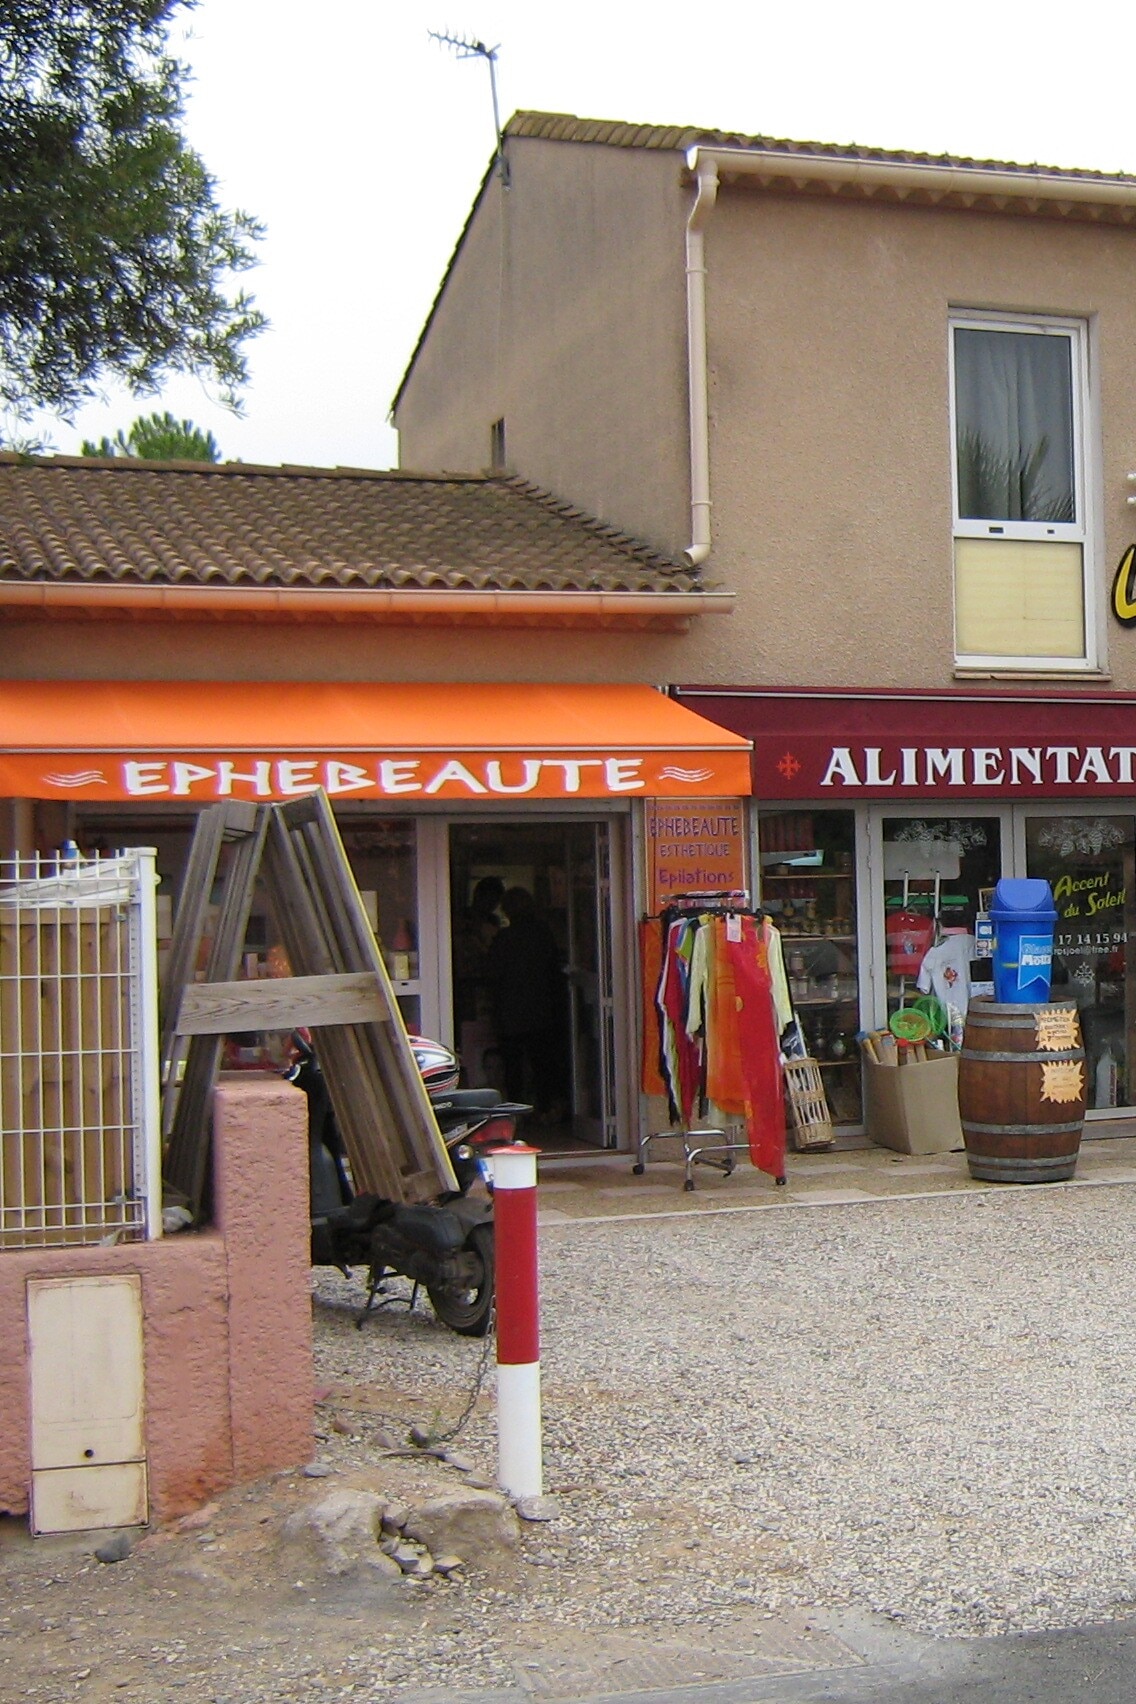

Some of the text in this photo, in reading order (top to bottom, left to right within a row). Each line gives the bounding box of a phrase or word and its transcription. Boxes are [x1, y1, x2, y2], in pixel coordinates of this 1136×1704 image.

[123, 758, 647, 796] EPHEBEAUTE
[650, 816, 739, 837] EPHEBEAUTE
[660, 843, 730, 857] ESTHETIQUE
[658, 868, 735, 889] Epilations
[1053, 871, 1109, 900] Accent
[1063, 888, 1127, 918] du Soleil
[1058, 932, 1128, 945] 17 14 15 94
